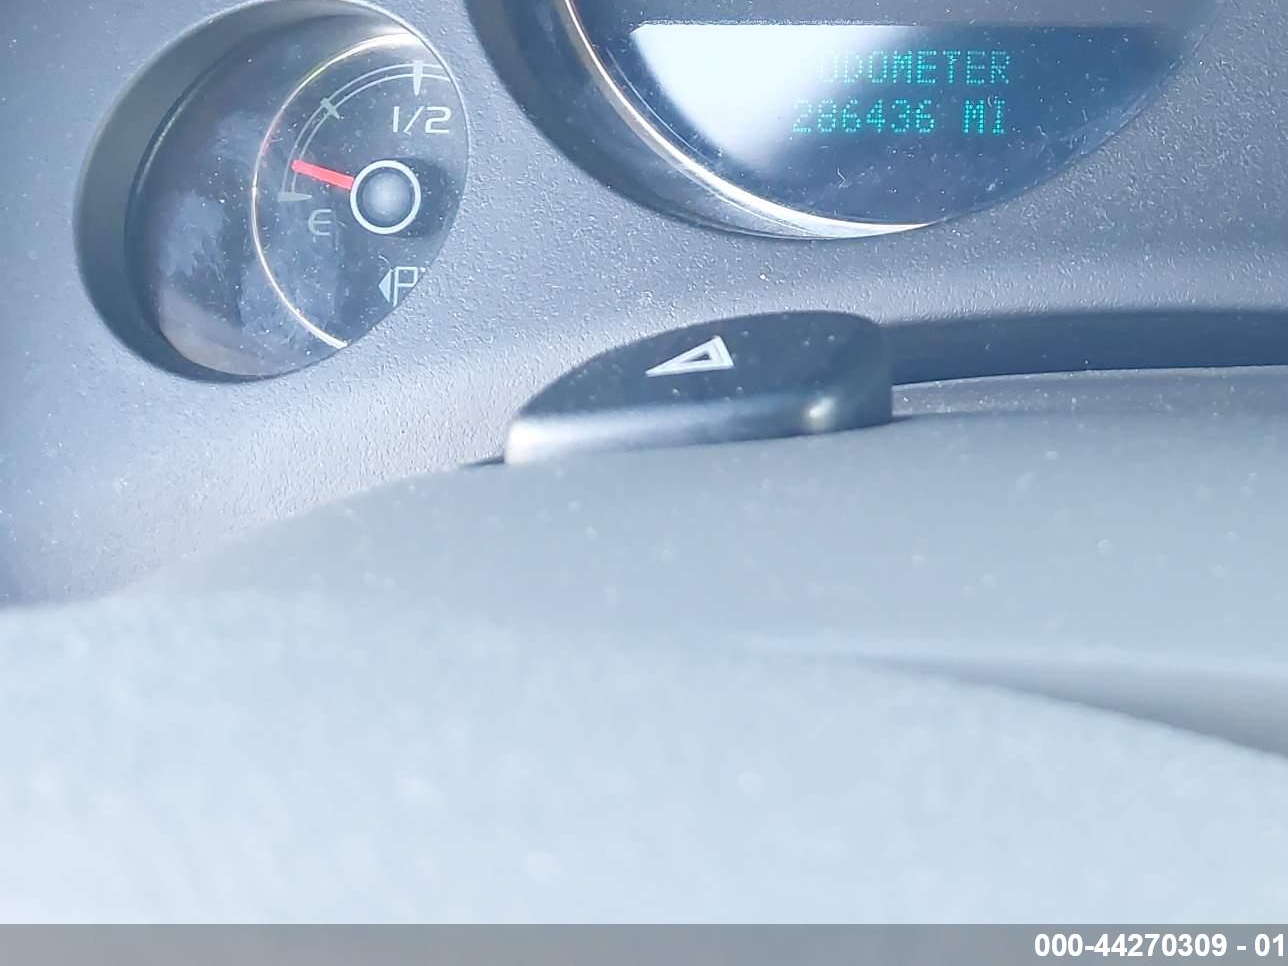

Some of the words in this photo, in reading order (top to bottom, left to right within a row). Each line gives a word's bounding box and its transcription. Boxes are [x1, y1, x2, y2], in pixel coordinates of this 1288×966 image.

[817, 49, 1011, 84] ODOMETER
[392, 105, 452, 136] 1/2
[792, 98, 935, 134] 286436
[963, 99, 1006, 134] MI
[307, 208, 332, 236] E
